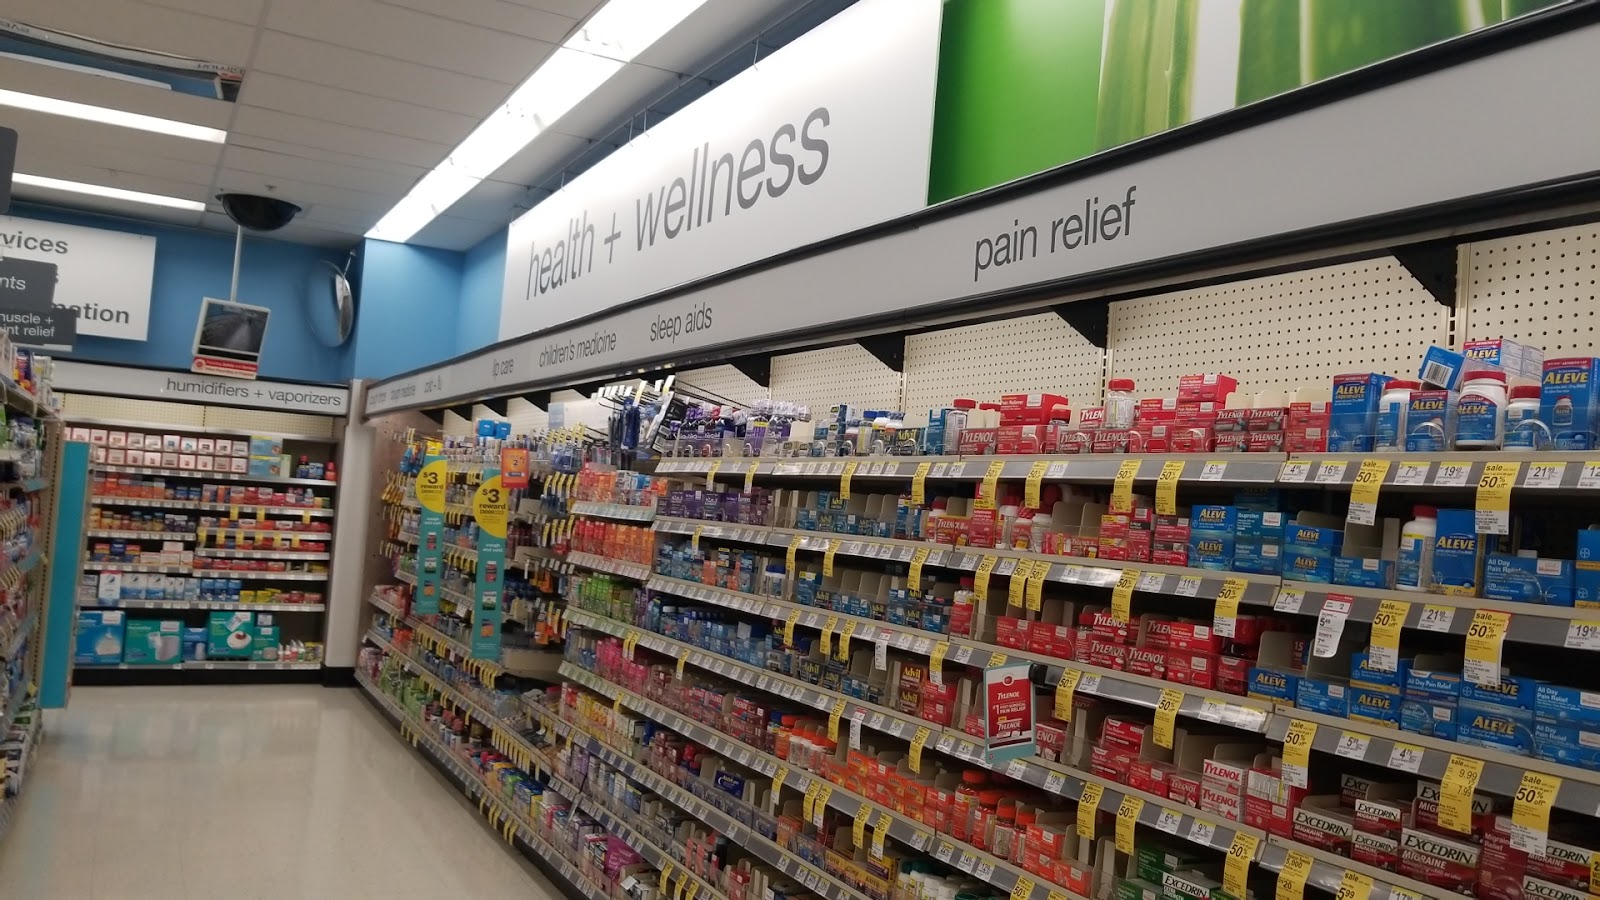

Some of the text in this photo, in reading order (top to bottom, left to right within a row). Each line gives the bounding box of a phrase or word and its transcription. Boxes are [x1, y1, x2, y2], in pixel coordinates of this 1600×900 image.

[526, 106, 831, 300] health + wellness
[975, 186, 1137, 282] pain relief
[0, 231, 69, 255] vices
[51, 302, 130, 324] ation
[650, 305, 713, 342] sleep aids
[23, 325, 56, 337] relief
[538, 332, 617, 368] children's medicine
[1465, 348, 1499, 359] ALEVE
[1543, 372, 1589, 385] ALEVE
[166, 377, 342, 406] humidifiers + vaporizers
[1335, 385, 1365, 395] ALEVE
[1410, 400, 1445, 410] ALEVE
[1217, 410, 1245, 420] TYLENOL
[1250, 409, 1282, 419] TYLENOL
[961, 430, 995, 444] TYLENOL
[1060, 431, 1090, 443] TYLENOL
[1094, 430, 1128, 443] TYLENOL
[1217, 433, 1245, 443] TYLENOL
[1250, 432, 1282, 443] TYLENOL
[1486, 464, 1503, 472] sale
[423, 472, 439, 485] $3
[482, 488, 500, 504] $3
[1199, 508, 1227, 520] ALEVE
[1237, 512, 1260, 520] Ibuprofen
[1296, 529, 1320, 540] ALEVE
[1197, 540, 1224, 552] ALEVE
[1435, 535, 1476, 550] ALEVE
[1294, 556, 1318, 568] ALEVE
[1487, 558, 1511, 568] All Day
[1502, 566, 1522, 574] Relief
[1380, 602, 1395, 610] sale
[1475, 612, 1493, 621] sale
[1091, 640, 1125, 657] TYLENOL
[1128, 647, 1165, 664] TYLENOL
[903, 666, 921, 679] Advil
[1255, 672, 1287, 688] ALEVE
[1414, 679, 1425, 688] Day
[1425, 680, 1436, 688] Pain
[1436, 682, 1452, 690] Relief
[901, 690, 918, 704] Advil
[997, 691, 1020, 701] TYLENOL
[1548, 687, 1559, 696] Day
[1359, 693, 1391, 709] ALEVE
[1550, 694, 1569, 703] Relief
[1290, 721, 1304, 729] sale
[1472, 715, 1516, 735] ALEVE
[1545, 726, 1557, 734] Day
[1549, 732, 1567, 741] Relief
[1451, 759, 1464, 767] sale
[1204, 761, 1241, 781] TYLENOL
[1459, 769, 1478, 781] 9.99
[1523, 774, 1542, 785] sale
[1458, 785, 1472, 797] 7.99
[1202, 788, 1239, 808] TYLENOL
[1356, 812, 1379, 822] MIGRAINE
[1357, 802, 1399, 820] EXCEDRIN
[1294, 812, 1349, 837] EXCEDRIN
[1294, 824, 1324, 839] MIGRAINE
[1354, 833, 1398, 852] EXCEDRIN
[1484, 840, 1504, 851] Relief
[1404, 834, 1474, 865] EXCEDRIN
[1402, 850, 1447, 870] MIGRAINE
[1344, 872, 1359, 882] sale
[1164, 875, 1207, 897] EXCEDRIN
